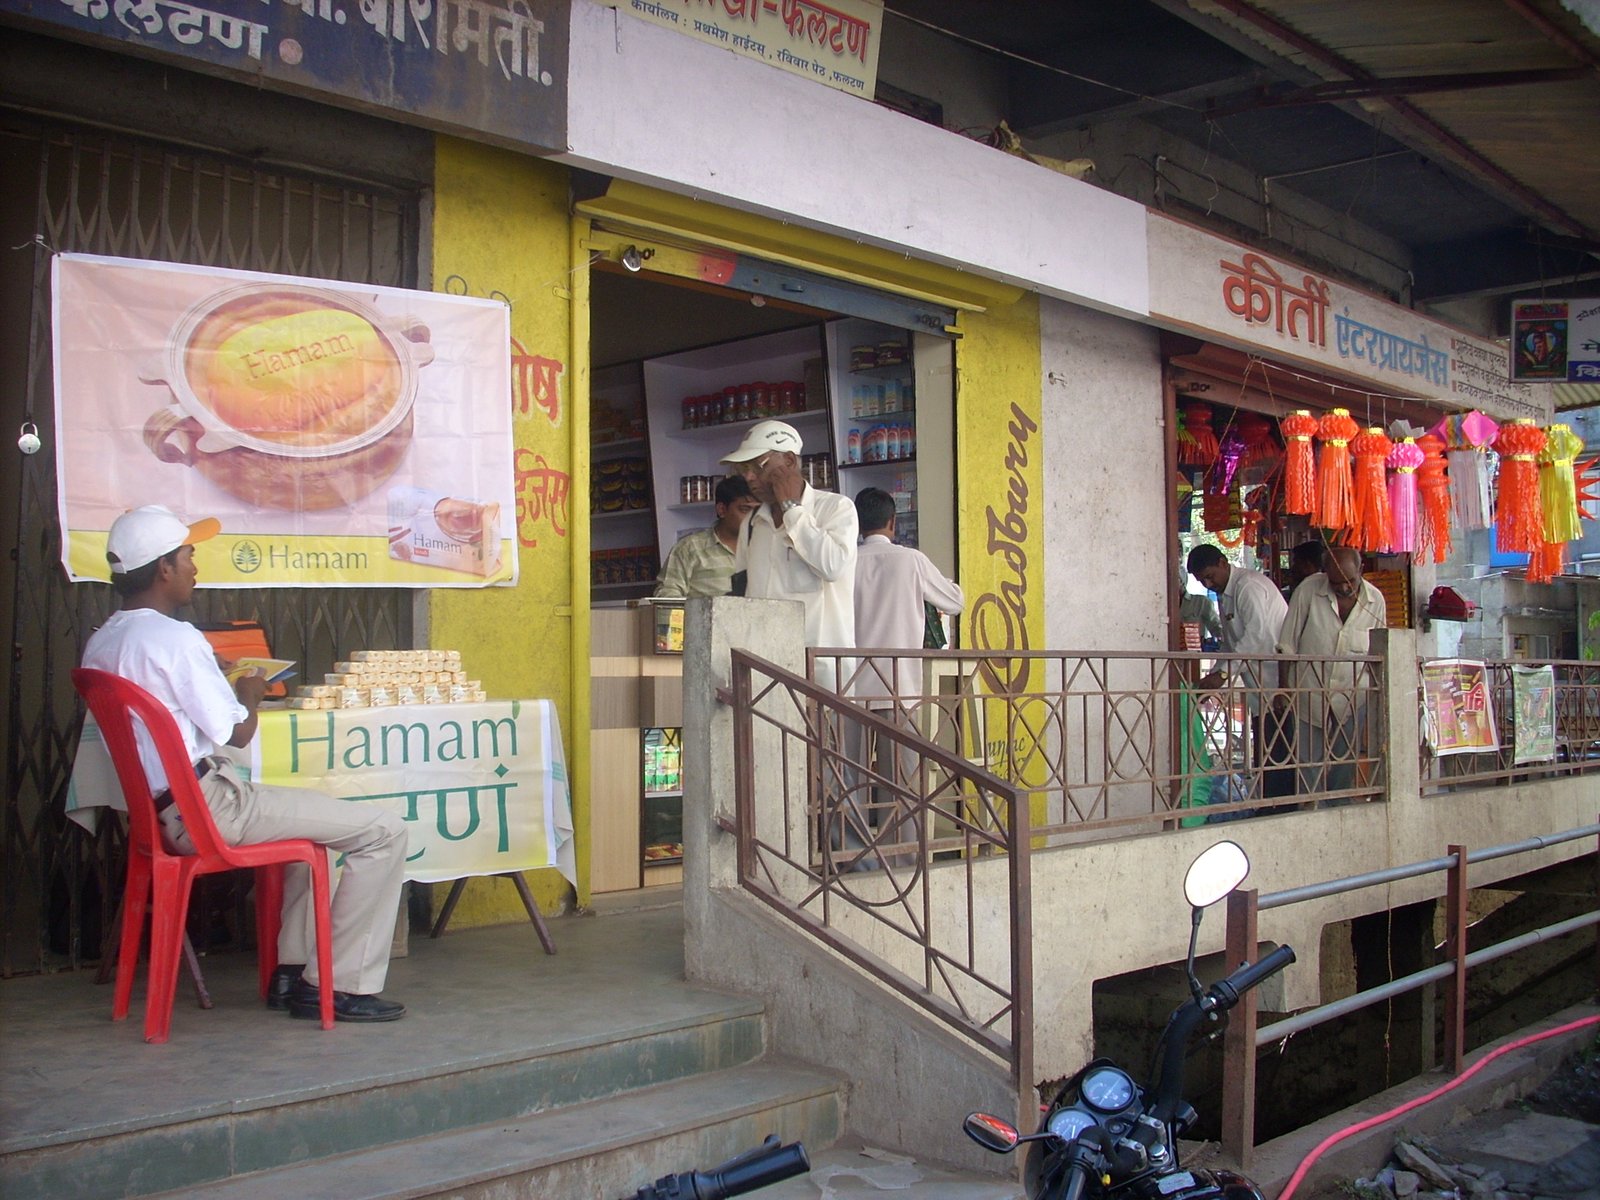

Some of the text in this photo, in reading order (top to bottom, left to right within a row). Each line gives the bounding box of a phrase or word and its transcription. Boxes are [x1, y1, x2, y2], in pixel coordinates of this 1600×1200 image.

[694, 19, 729, 42] प्रथमेश
[777, 48, 809, 71] रविवार
[811, 58, 826, 77] पेठ
[239, 333, 356, 381] Hamam
[269, 544, 368, 569] Hamam
[414, 533, 462, 554] Hamam
[970, 401, 1038, 700] Cadbury
[290, 710, 519, 773] Hamam
